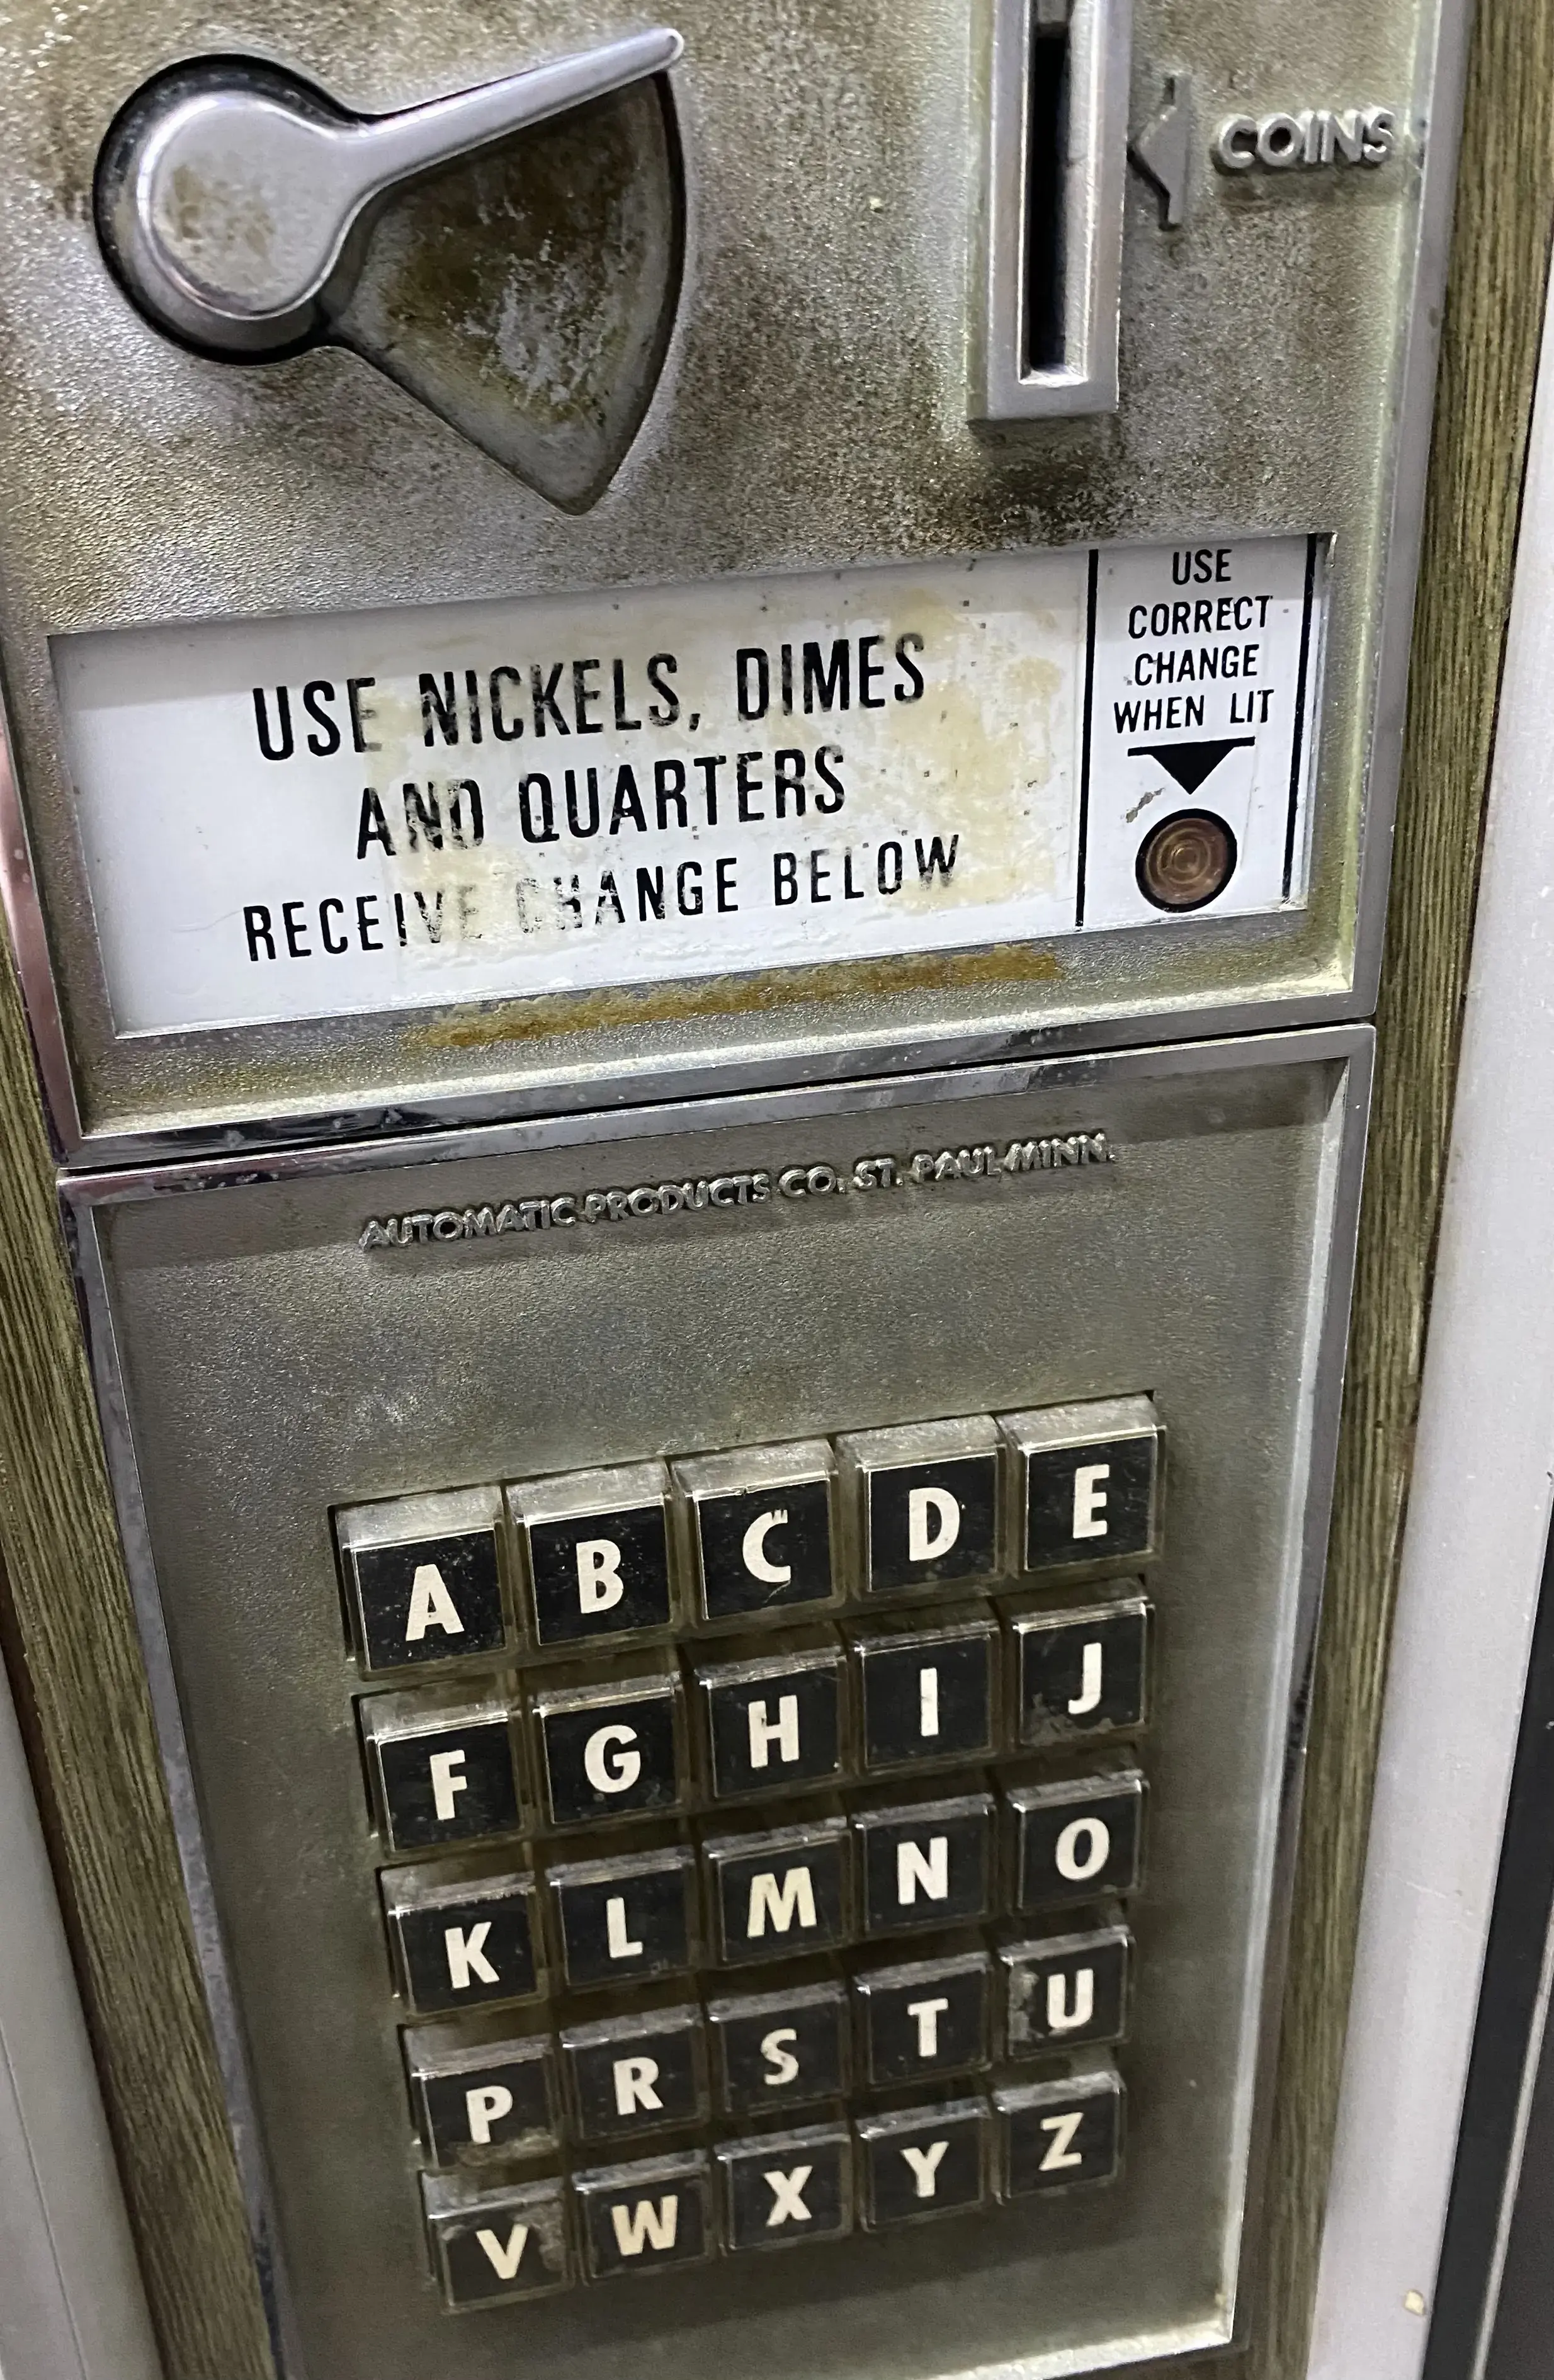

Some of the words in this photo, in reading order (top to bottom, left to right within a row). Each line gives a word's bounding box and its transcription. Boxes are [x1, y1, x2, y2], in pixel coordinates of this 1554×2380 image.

[1218, 105, 1396, 170] COINS
[1172, 549, 1232, 586] USE
[1128, 595, 1273, 639] CORRECT
[252, 677, 382, 761] USE
[418, 652, 701, 747] NICKELS,
[735, 632, 924, 721] DIMES
[1135, 643, 1260, 686] CHANGE
[1114, 696, 1205, 734] WHEN
[1230, 689, 1274, 724] LIT
[356, 778, 485, 859] AND
[518, 744, 844, 843] QUARTERS
[243, 884, 484, 962] RECEIVE
[516, 857, 739, 934] CHANGE
[773, 834, 960, 907] BELOW
[358, 1195, 577, 1252] AUTOMATIC
[586, 1172, 772, 1224] PRODUCTS
[778, 1165, 846, 1198] CO.
[853, 1157, 904, 1187] ST.
[1004, 1132, 1116, 1172] MINN.
[909, 1487, 960, 1561] D
[1073, 1464, 1109, 1539] E
[576, 1539, 624, 1614] B
[743, 1509, 791, 1584] C
[406, 1564, 464, 1641] A
[921, 1667, 939, 1737] I
[1068, 1642, 1102, 1714] J
[584, 1725, 641, 1793] G
[748, 1695, 799, 1768] H
[429, 1750, 467, 1821] F
[897, 1837, 948, 1905] N
[1055, 1817, 1109, 1881] O
[606, 1897, 643, 1958] L
[747, 1866, 817, 1937] M
[445, 1922, 500, 1989] K
[907, 1998, 948, 2057] T
[1046, 1968, 1094, 2029] U
[613, 2056, 664, 2116] R
[761, 2028, 799, 2085] S
[466, 2085, 513, 2144] P
[1038, 2112, 1084, 2171] Z
[764, 2166, 813, 2226] X
[902, 2141, 949, 2197] Y
[476, 2224, 528, 2280] V
[611, 2195, 678, 2256] W
